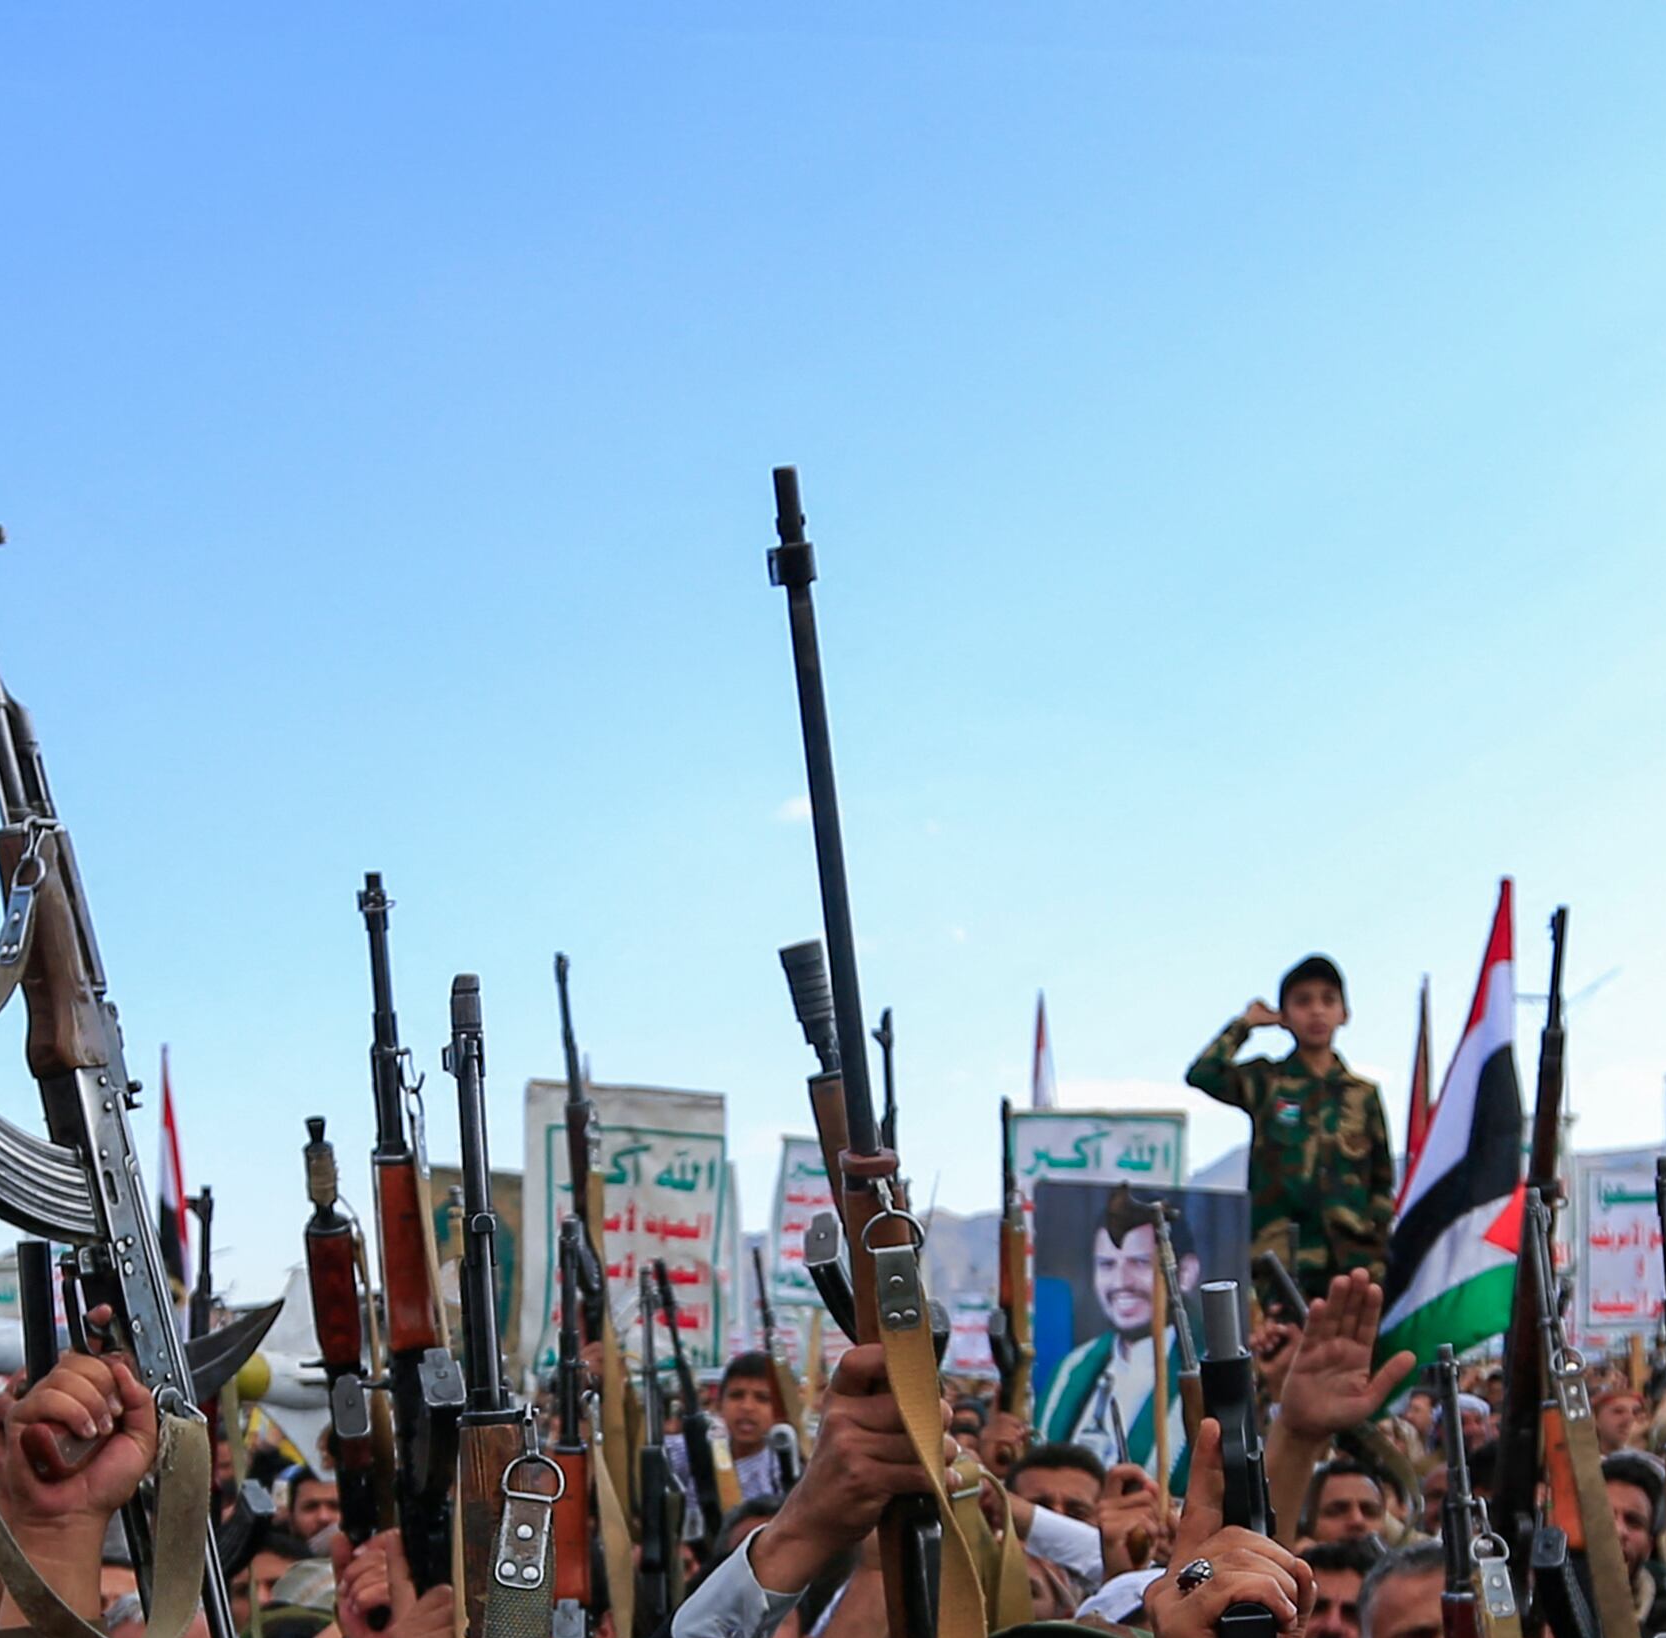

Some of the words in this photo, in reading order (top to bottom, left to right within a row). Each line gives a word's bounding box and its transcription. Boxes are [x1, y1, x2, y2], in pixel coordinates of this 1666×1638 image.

[652, 1150, 715, 1192] الله
[1022, 1123, 1111, 1181] أكبر
[1117, 1131, 1171, 1171] الله
[644, 1212, 712, 1242] الموت
